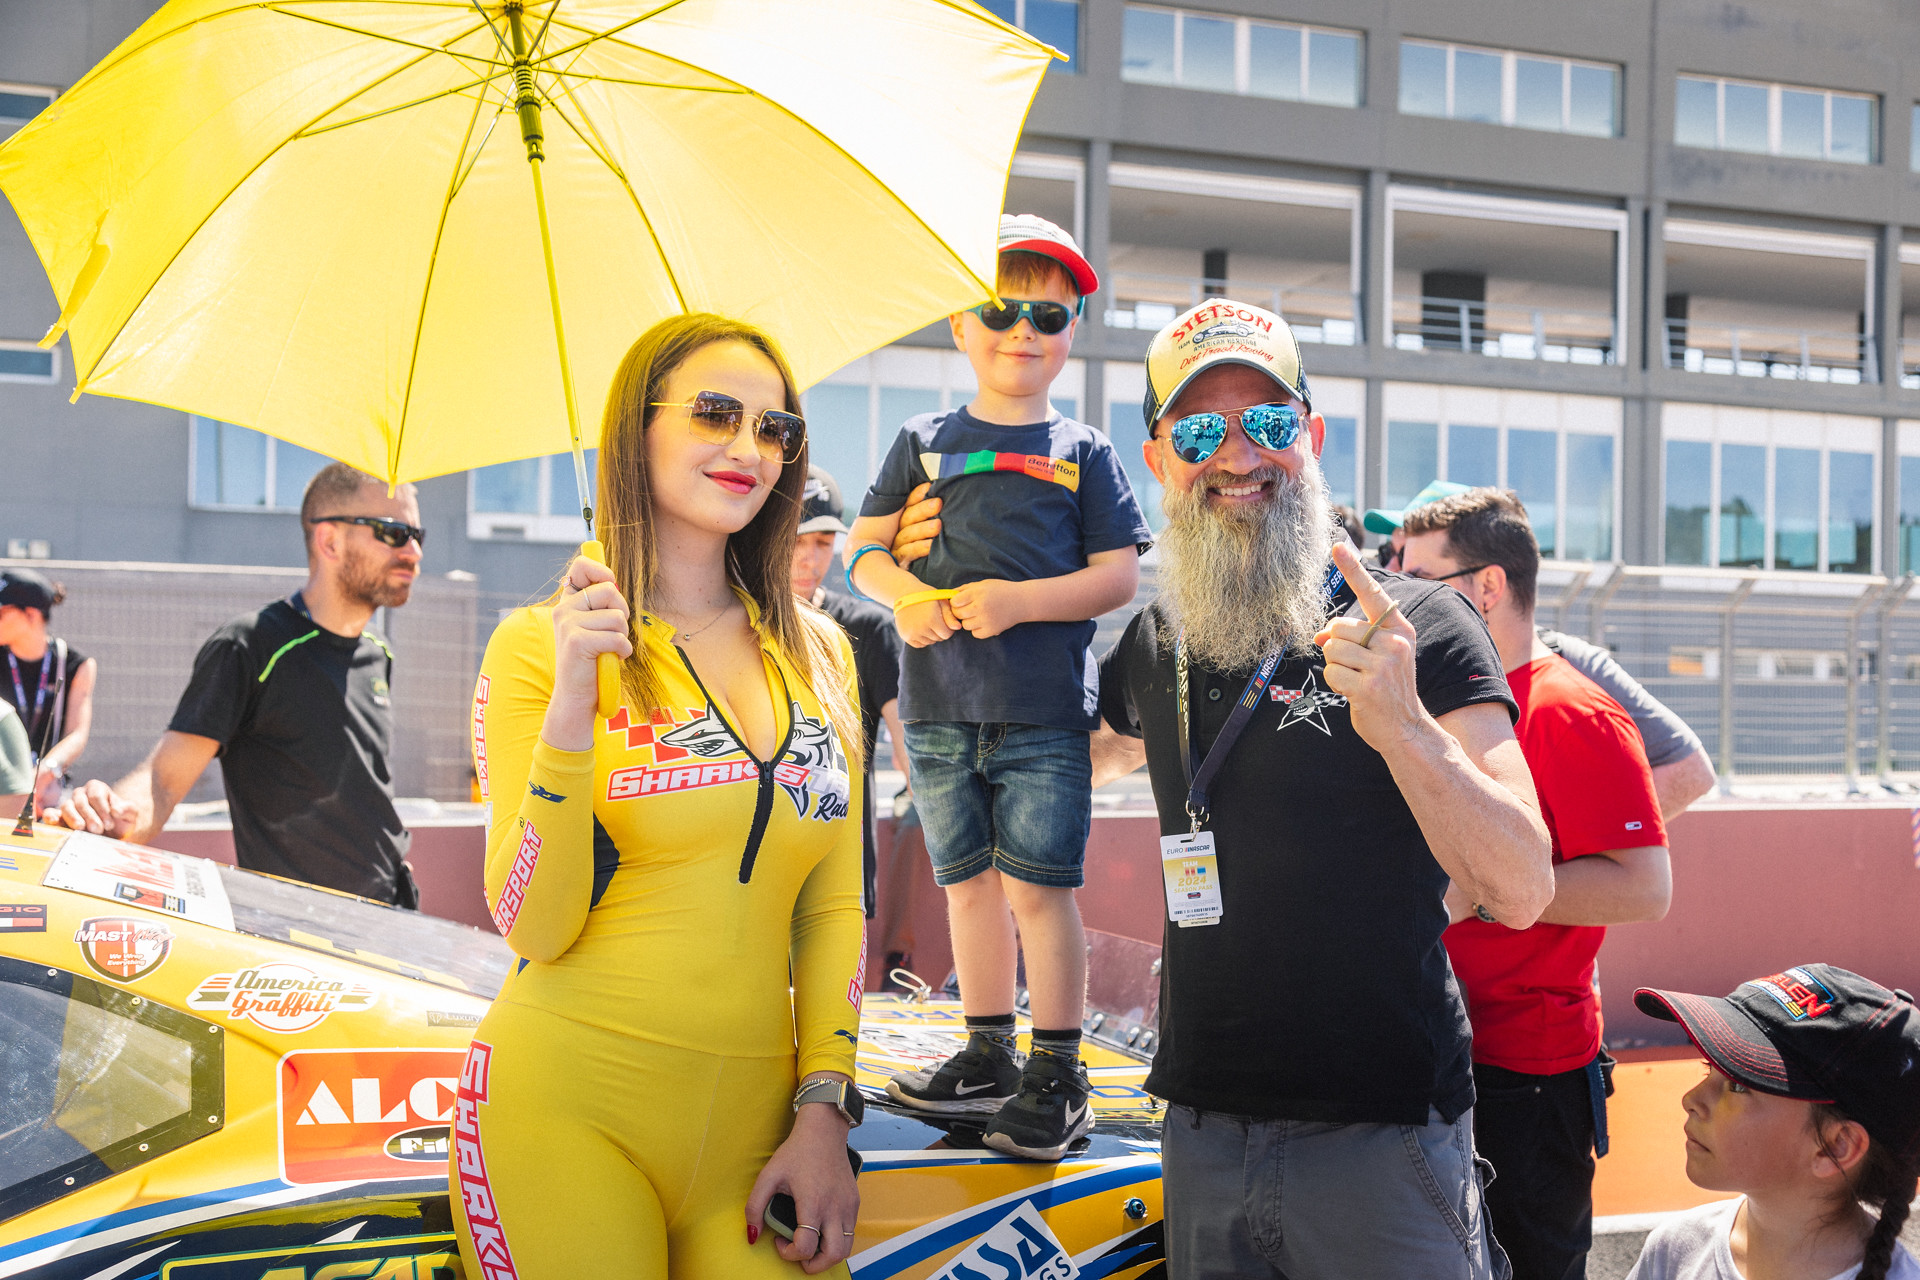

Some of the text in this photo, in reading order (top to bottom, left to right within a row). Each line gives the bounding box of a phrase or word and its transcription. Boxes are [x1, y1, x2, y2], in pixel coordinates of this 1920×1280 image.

[1170, 304, 1273, 344] STETSON
[1193, 339, 1226, 352] AMERICAN
[1027, 457, 1076, 478] Benetton
[1260, 645, 1282, 679] NASCA
[474, 674, 491, 797] SHARKS
[607, 757, 811, 801] SHARKS
[1188, 844, 1210, 852] NASCAR
[1173, 884, 1213, 894] SEASON PASS
[1178, 875, 1207, 887] 2024
[0, 906, 43, 914] GIO
[75, 930, 132, 943] MAST
[107, 958, 147, 966] Everything
[234, 969, 348, 993] America
[231, 990, 336, 1017] Graffiti
[446, 1011, 481, 1024] Luxury
[295, 1077, 458, 1126] ALC
[455, 1039, 518, 1280] SHARK
